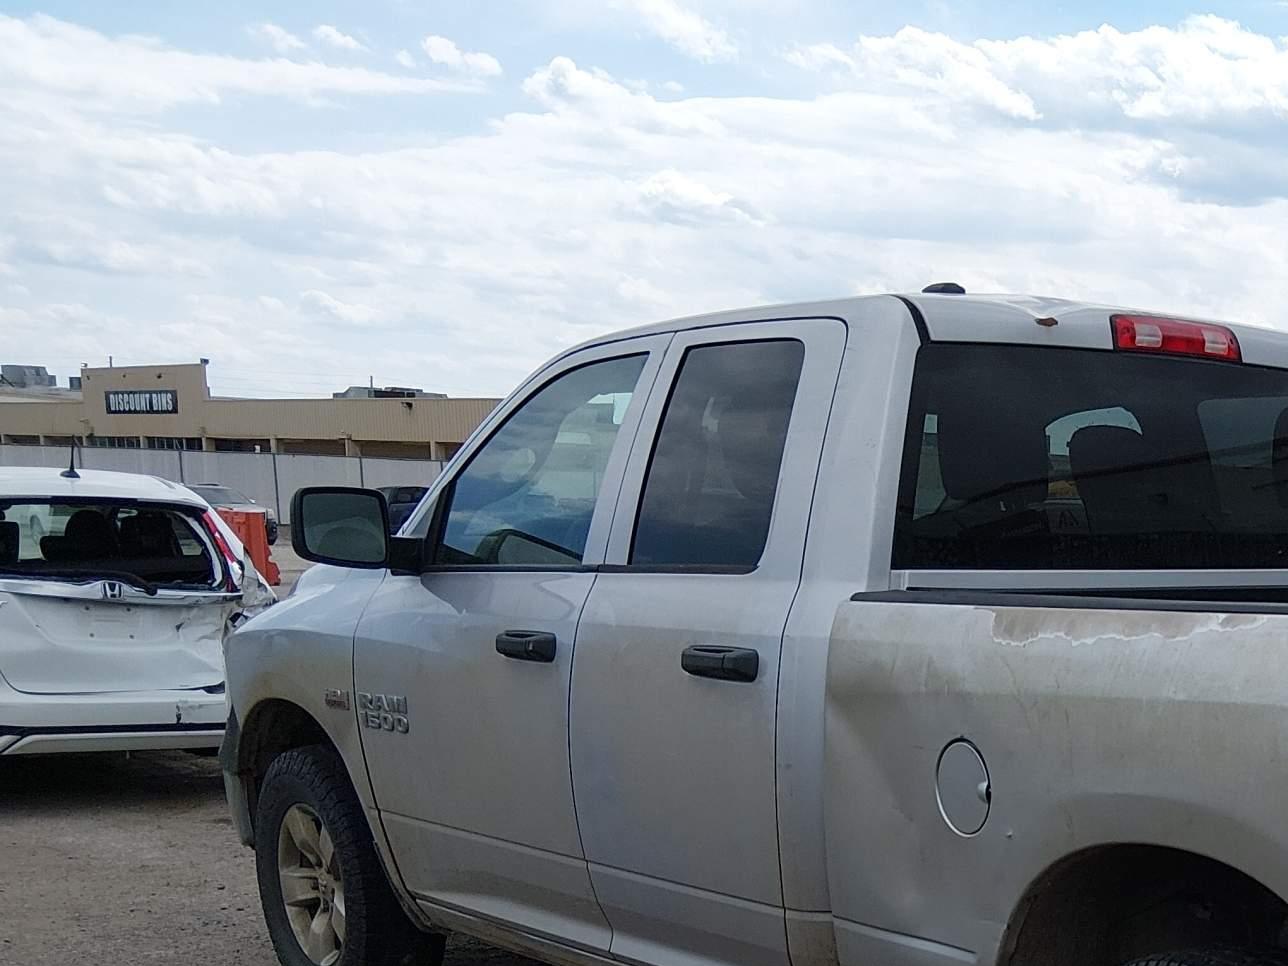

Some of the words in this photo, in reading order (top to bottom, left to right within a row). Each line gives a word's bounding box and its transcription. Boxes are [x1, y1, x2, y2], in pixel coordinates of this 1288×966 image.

[109, 393, 150, 411] DISCOUNT
[152, 393, 173, 411] BINS
[358, 692, 408, 714] RAM
[359, 711, 409, 734] 1500
